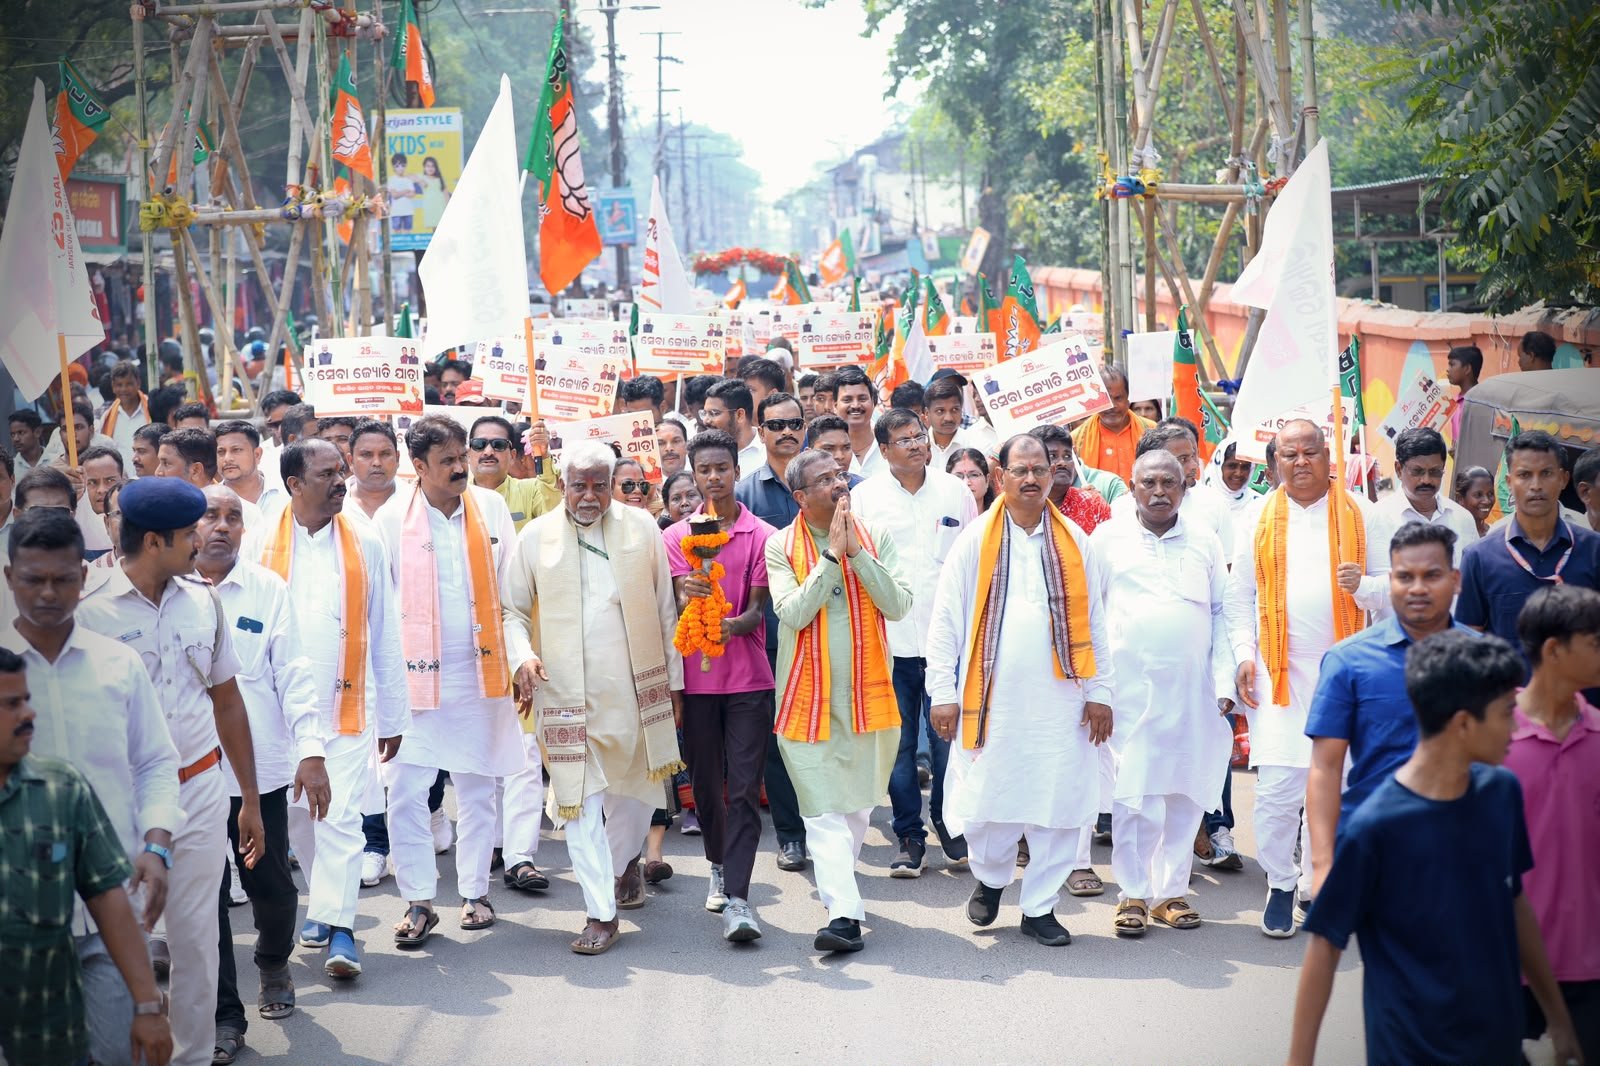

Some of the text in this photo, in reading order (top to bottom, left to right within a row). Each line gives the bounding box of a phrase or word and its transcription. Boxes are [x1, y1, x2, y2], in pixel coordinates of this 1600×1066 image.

[416, 115, 453, 126] STYLE
[388, 135, 427, 155] KIDS
[641, 336, 665, 346] ସେବା
[360, 347, 371, 355] 25
[489, 360, 515, 372] ସେବା
[568, 360, 577, 368] 25
[1022, 362, 1035, 373] 25
[317, 368, 349, 381] ସେବା
[353, 363, 391, 379] ଜ୍ୟୋତି
[395, 367, 419, 381] ଯାତ୍ରା
[535, 373, 556, 386] ସବା
[559, 377, 590, 391] ଜ୍ୟୋତି
[593, 382, 614, 396] ଯାତ୍ରା
[989, 390, 1022, 410] ସେବା
[1024, 371, 1063, 397] ଜ୍ୟୋତି
[1066, 364, 1094, 381] ଯାତ୍ରା
[589, 428, 600, 436] 25
[627, 440, 655, 453] ଯାତ୍ରା
